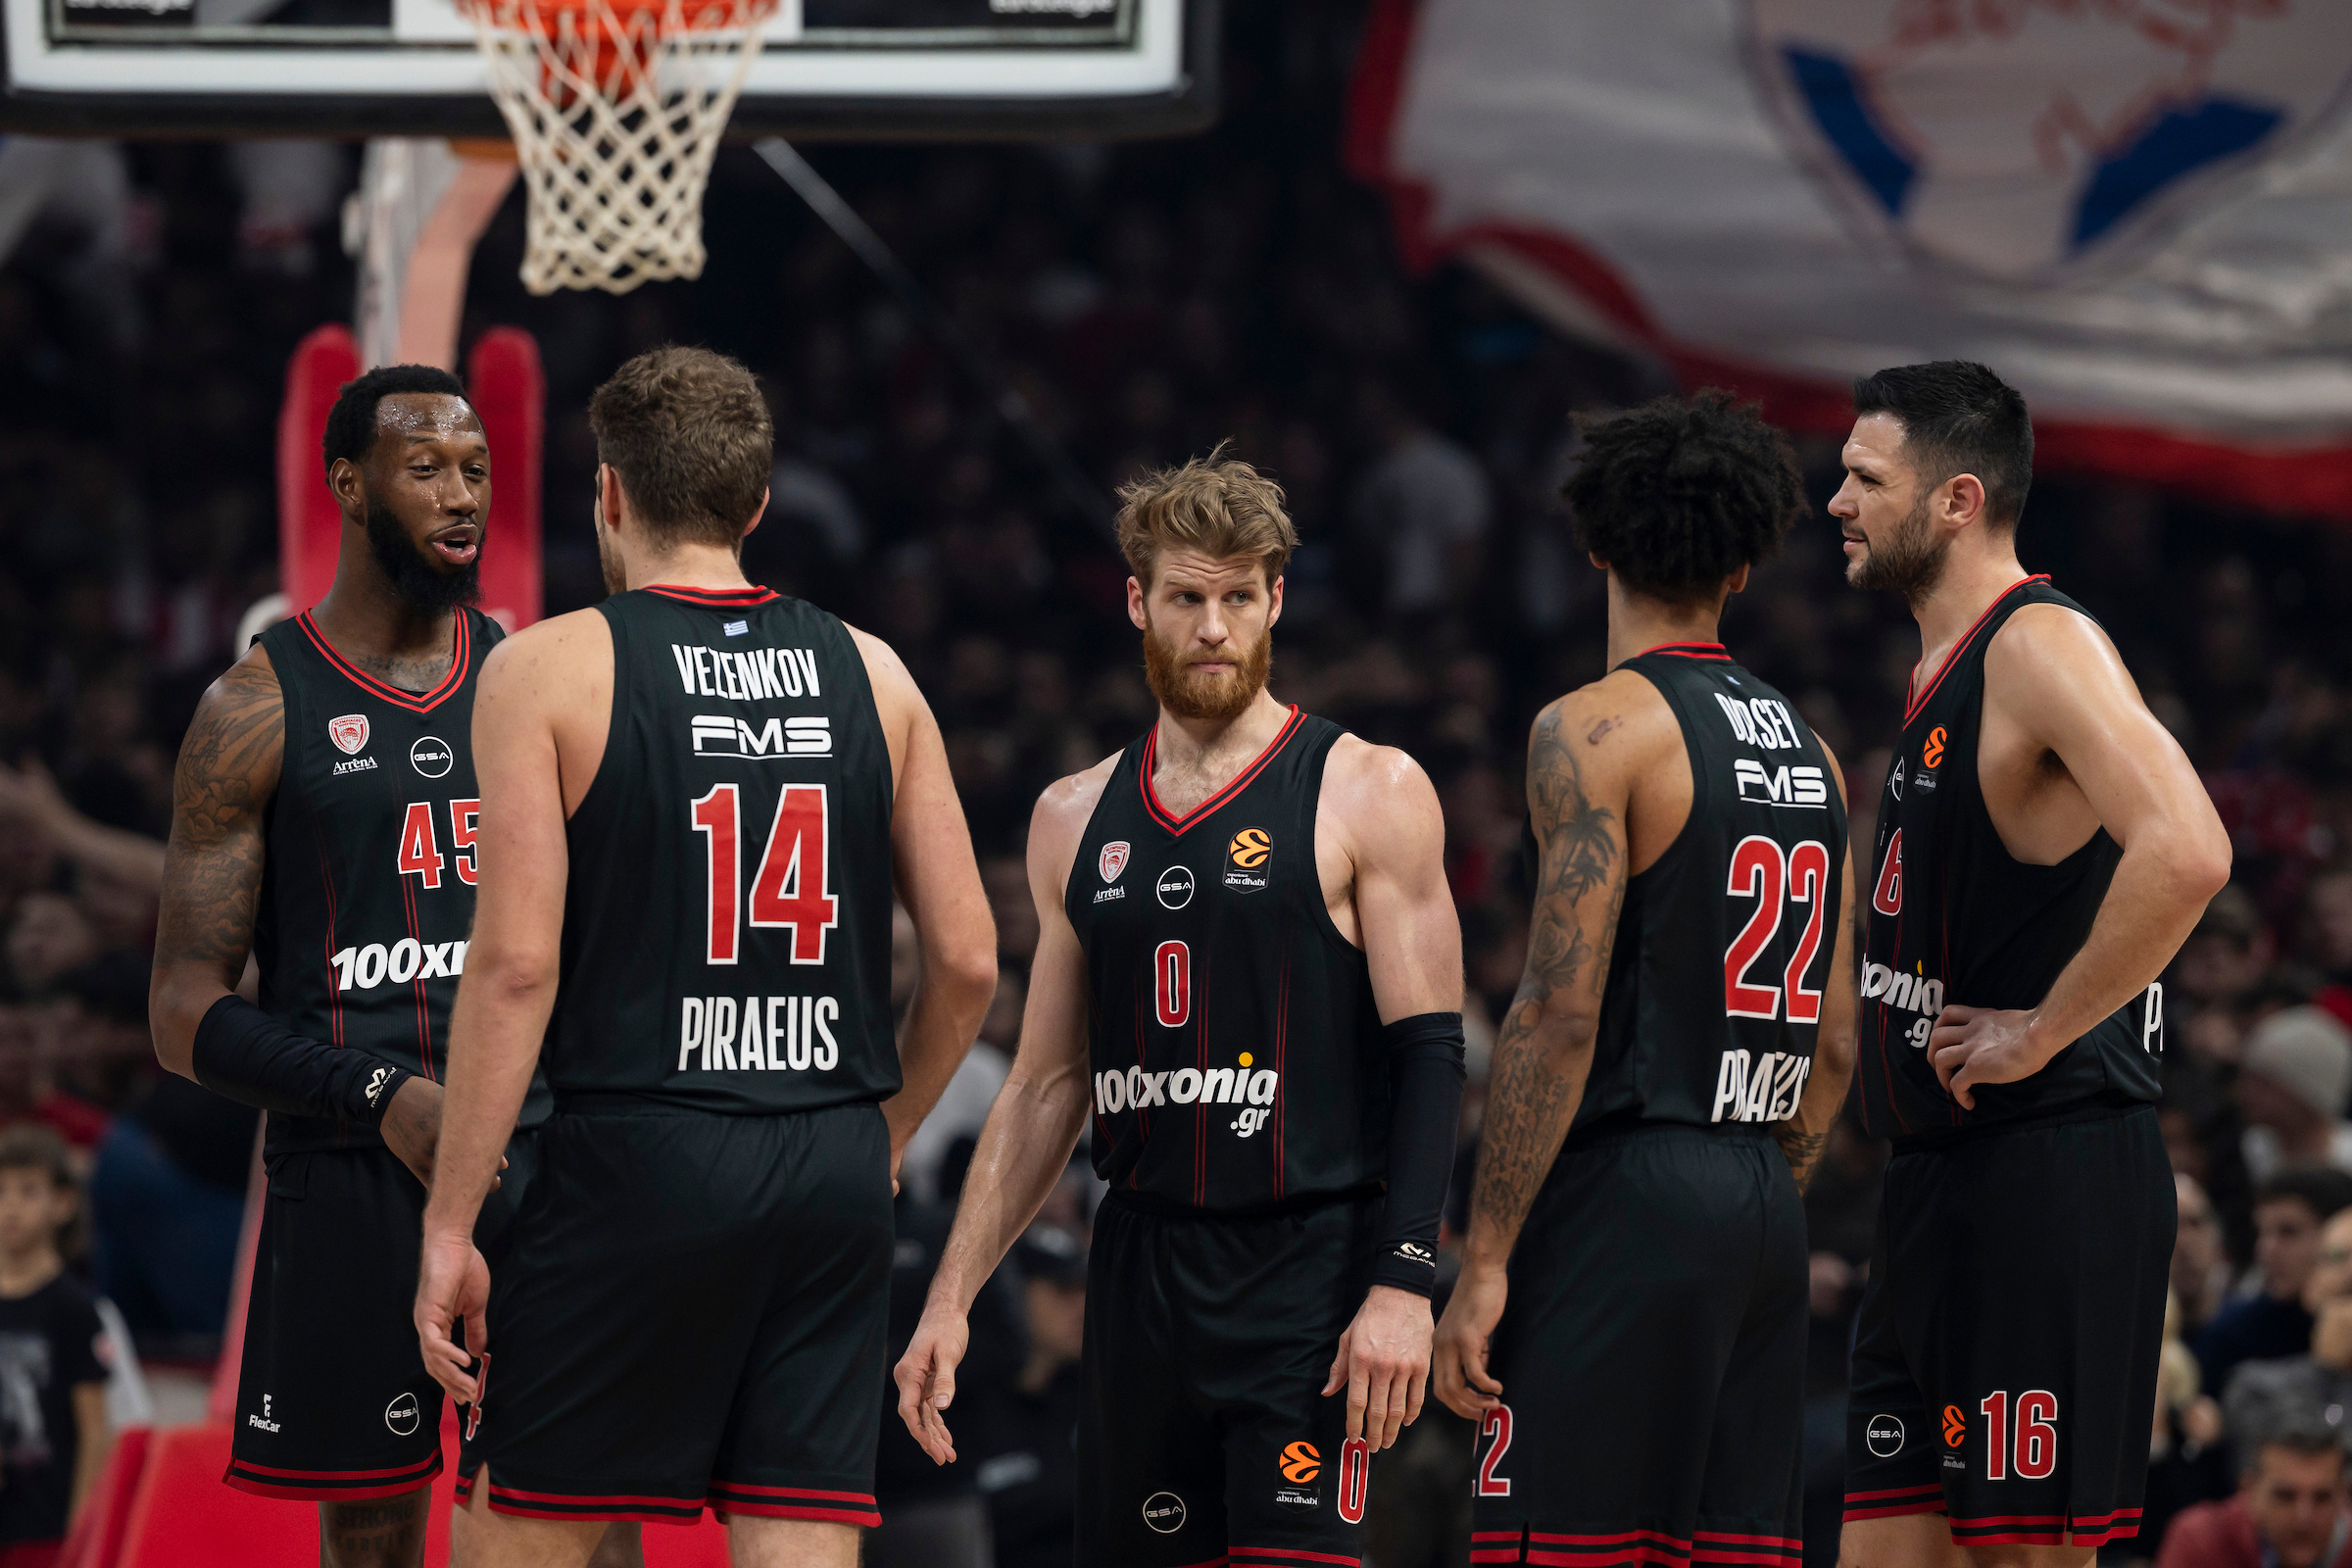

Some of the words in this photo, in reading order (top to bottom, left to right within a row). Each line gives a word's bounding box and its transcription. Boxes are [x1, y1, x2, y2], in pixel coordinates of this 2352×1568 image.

[670, 643, 821, 701] VEZENKOV
[414, 752, 450, 761] GSA
[691, 714, 833, 755] FMS
[1734, 759, 1827, 804] FMS
[397, 799, 480, 890] 45
[1873, 821, 1902, 916] 6
[690, 783, 839, 965] 14
[1159, 882, 1192, 892] GSA
[1724, 835, 1830, 1024] 22
[1154, 940, 1191, 1028] 0
[677, 996, 840, 1071] PIRAEUS
[1904, 1017, 1936, 1049] .g
[1230, 1107, 1270, 1138] .gr
[249, 1414, 280, 1433] FlexCar
[389, 1407, 417, 1418] GSA
[1870, 1430, 1902, 1439] GSA
[1981, 1390, 2058, 1480] 16
[1473, 1403, 1513, 1498] 2
[1338, 1437, 1369, 1524] 0
[1146, 1506, 1183, 1518] GSA
